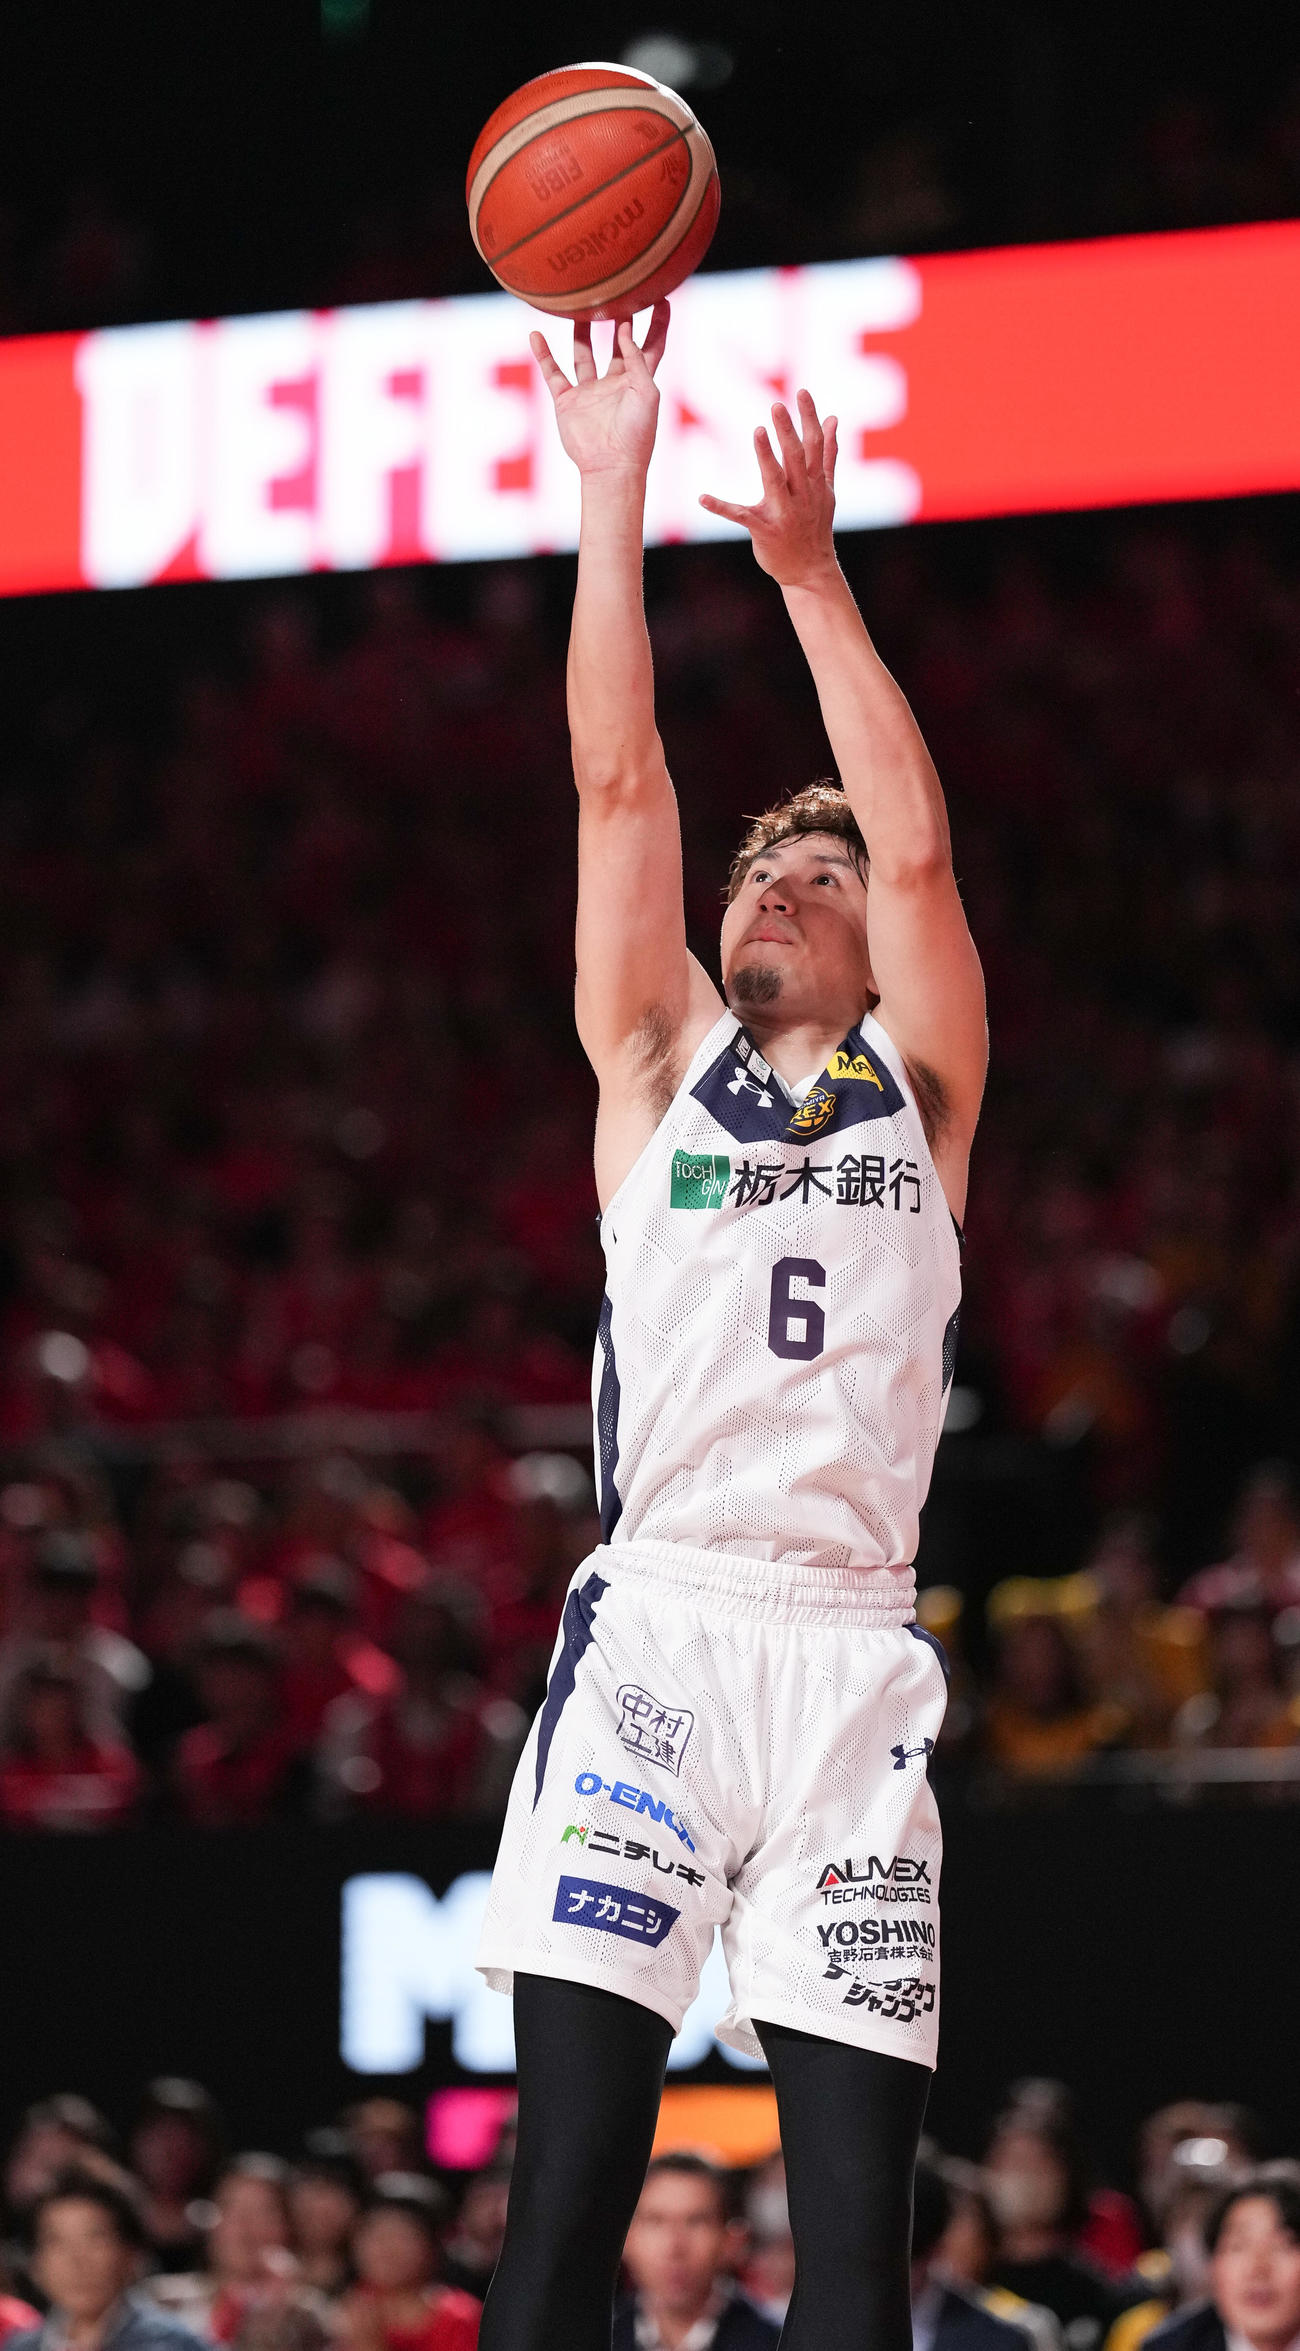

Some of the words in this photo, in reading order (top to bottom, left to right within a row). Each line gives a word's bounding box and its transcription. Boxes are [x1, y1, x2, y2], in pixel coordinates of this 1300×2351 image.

[548, 199, 646, 272] molten
[790, 1098, 833, 1124] REX
[729, 1153, 922, 1214] 栃木銀行
[768, 1256, 826, 1361] 6
[622, 1692, 685, 1739] 中村
[620, 1723, 677, 1766] 工建
[588, 1830, 706, 1888] ニチレキ
[816, 1855, 932, 1889] ALMEX
[567, 1889, 663, 1935] ナカニシ
[820, 1885, 931, 1906] TECHNOLOGIES
[816, 1919, 936, 1949] YOSHINO
[841, 1982, 922, 2023] シャンプー
